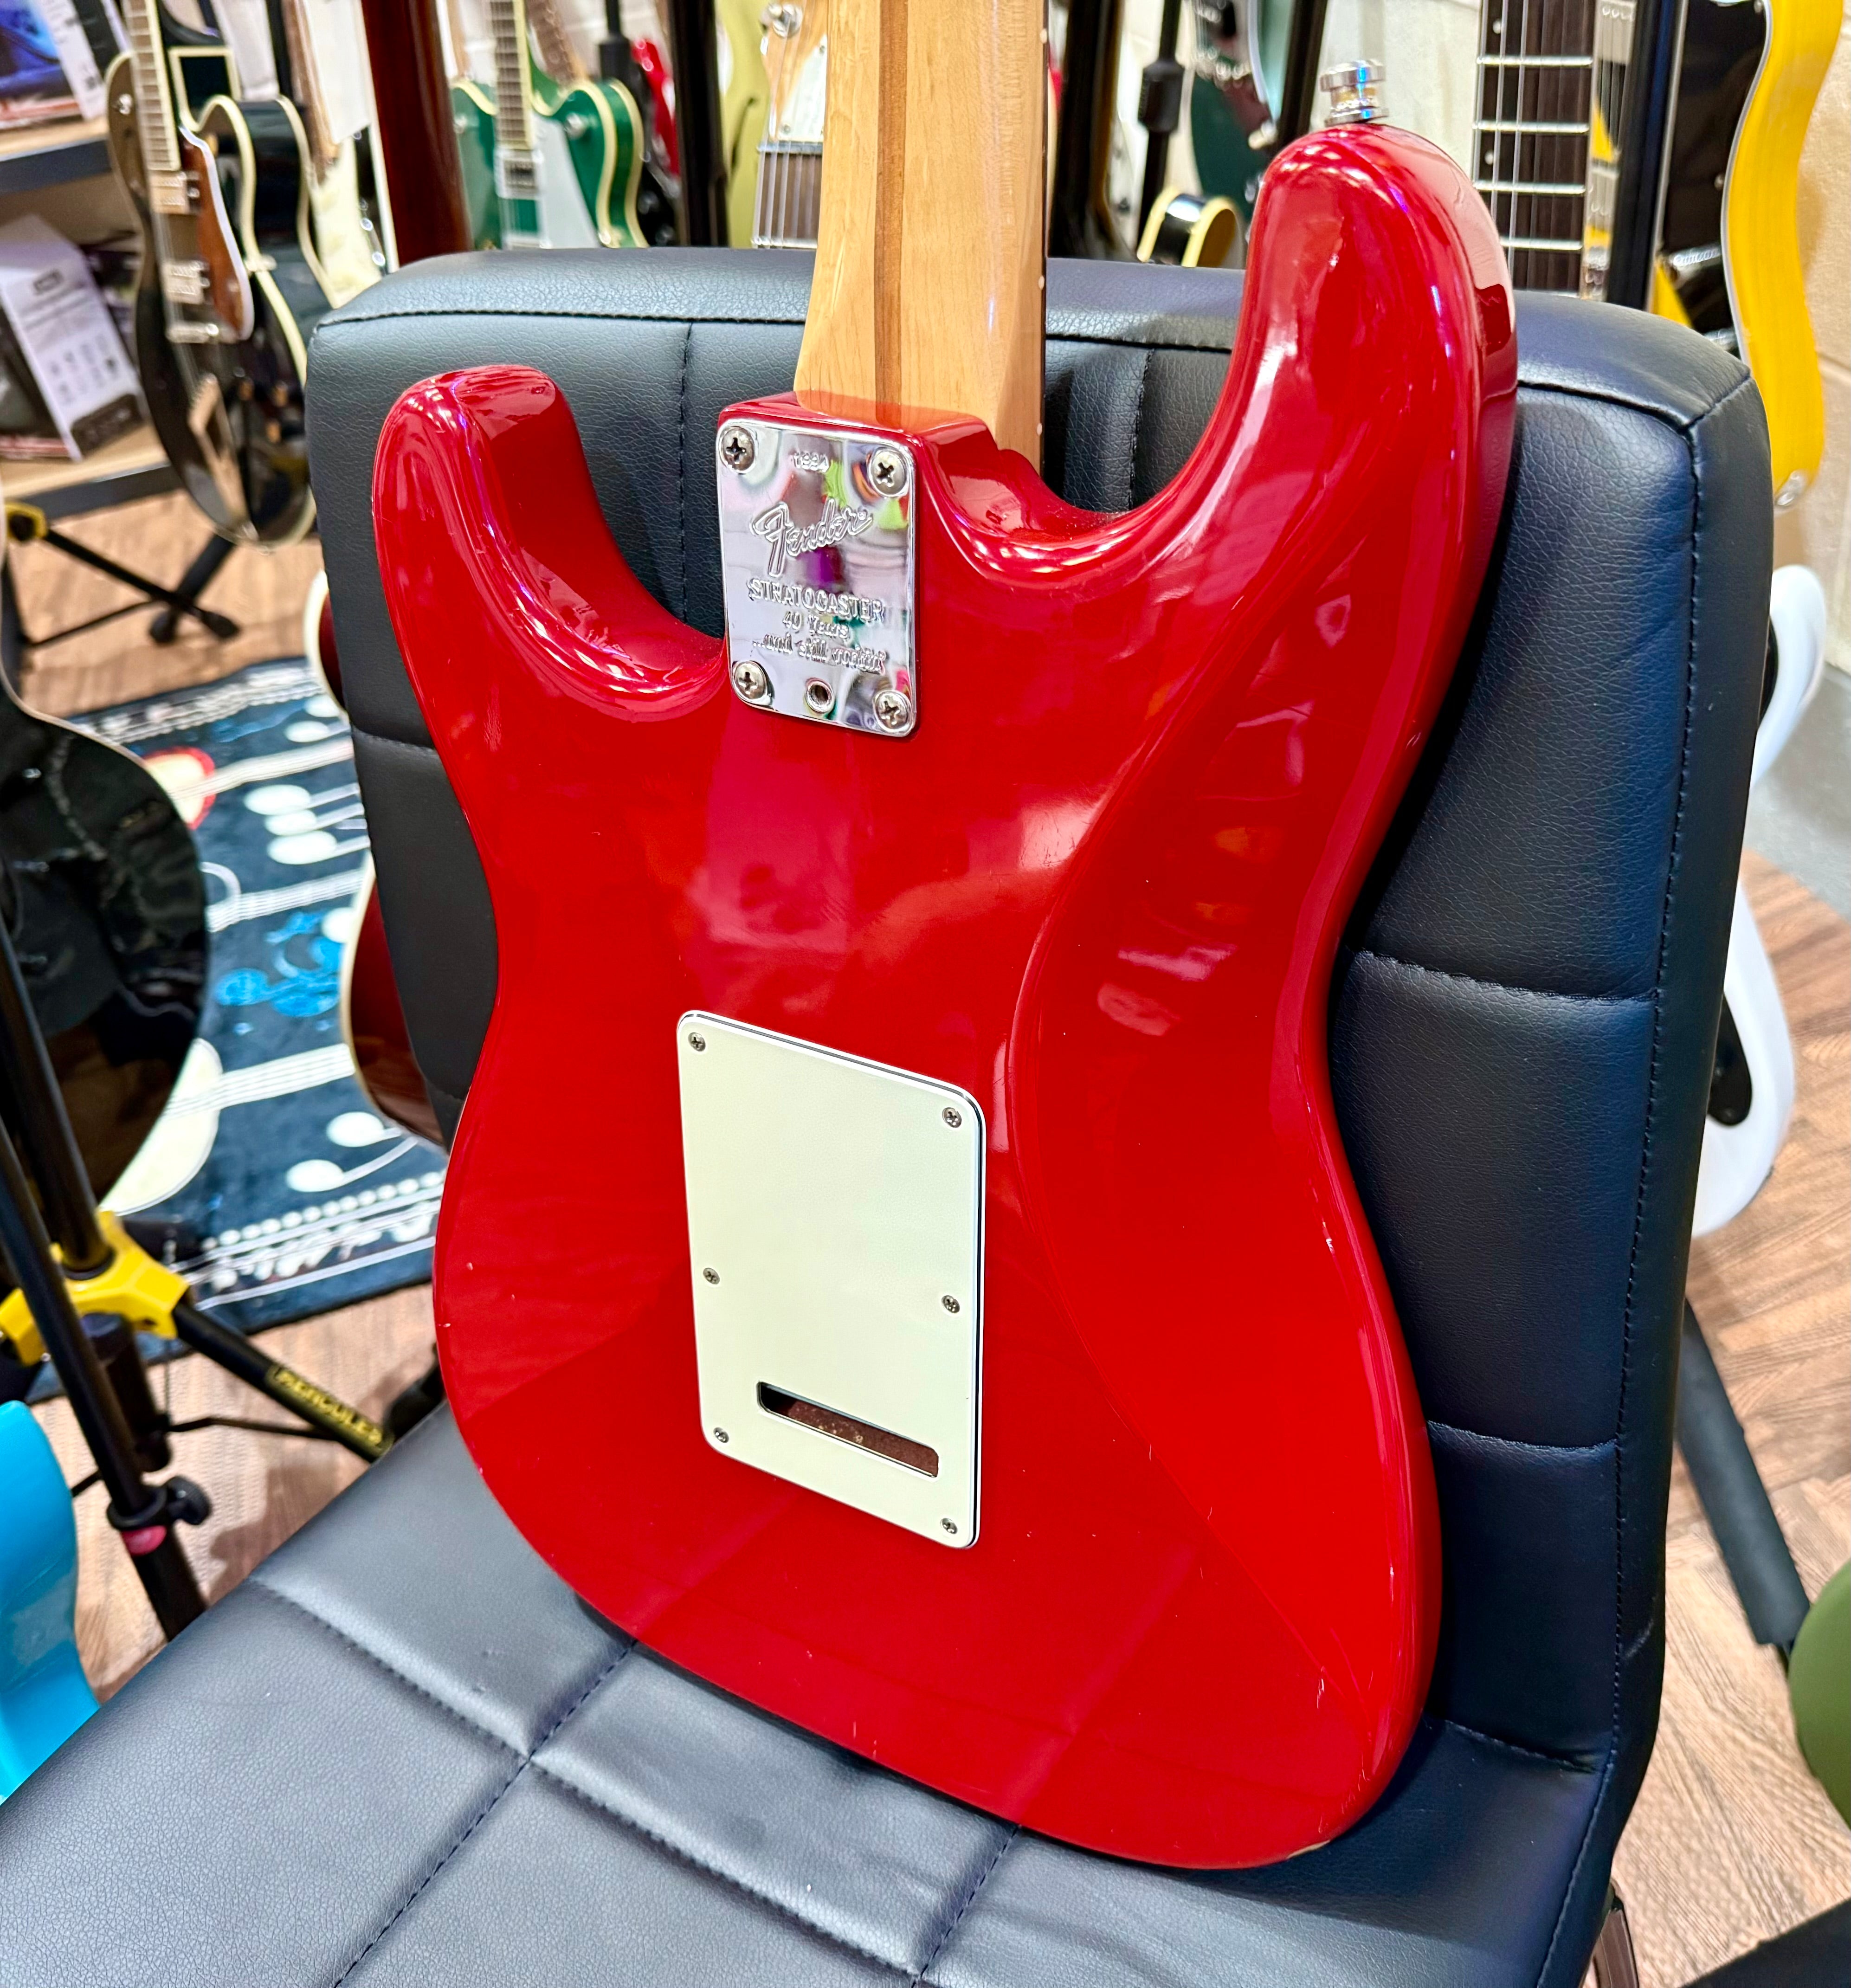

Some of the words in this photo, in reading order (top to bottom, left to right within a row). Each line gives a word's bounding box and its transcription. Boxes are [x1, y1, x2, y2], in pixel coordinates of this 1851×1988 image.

[747, 578, 885, 622] STRATOCASTER
[782, 611, 802, 632] 40
[808, 614, 849, 639] Years
[798, 639, 828, 662] still
